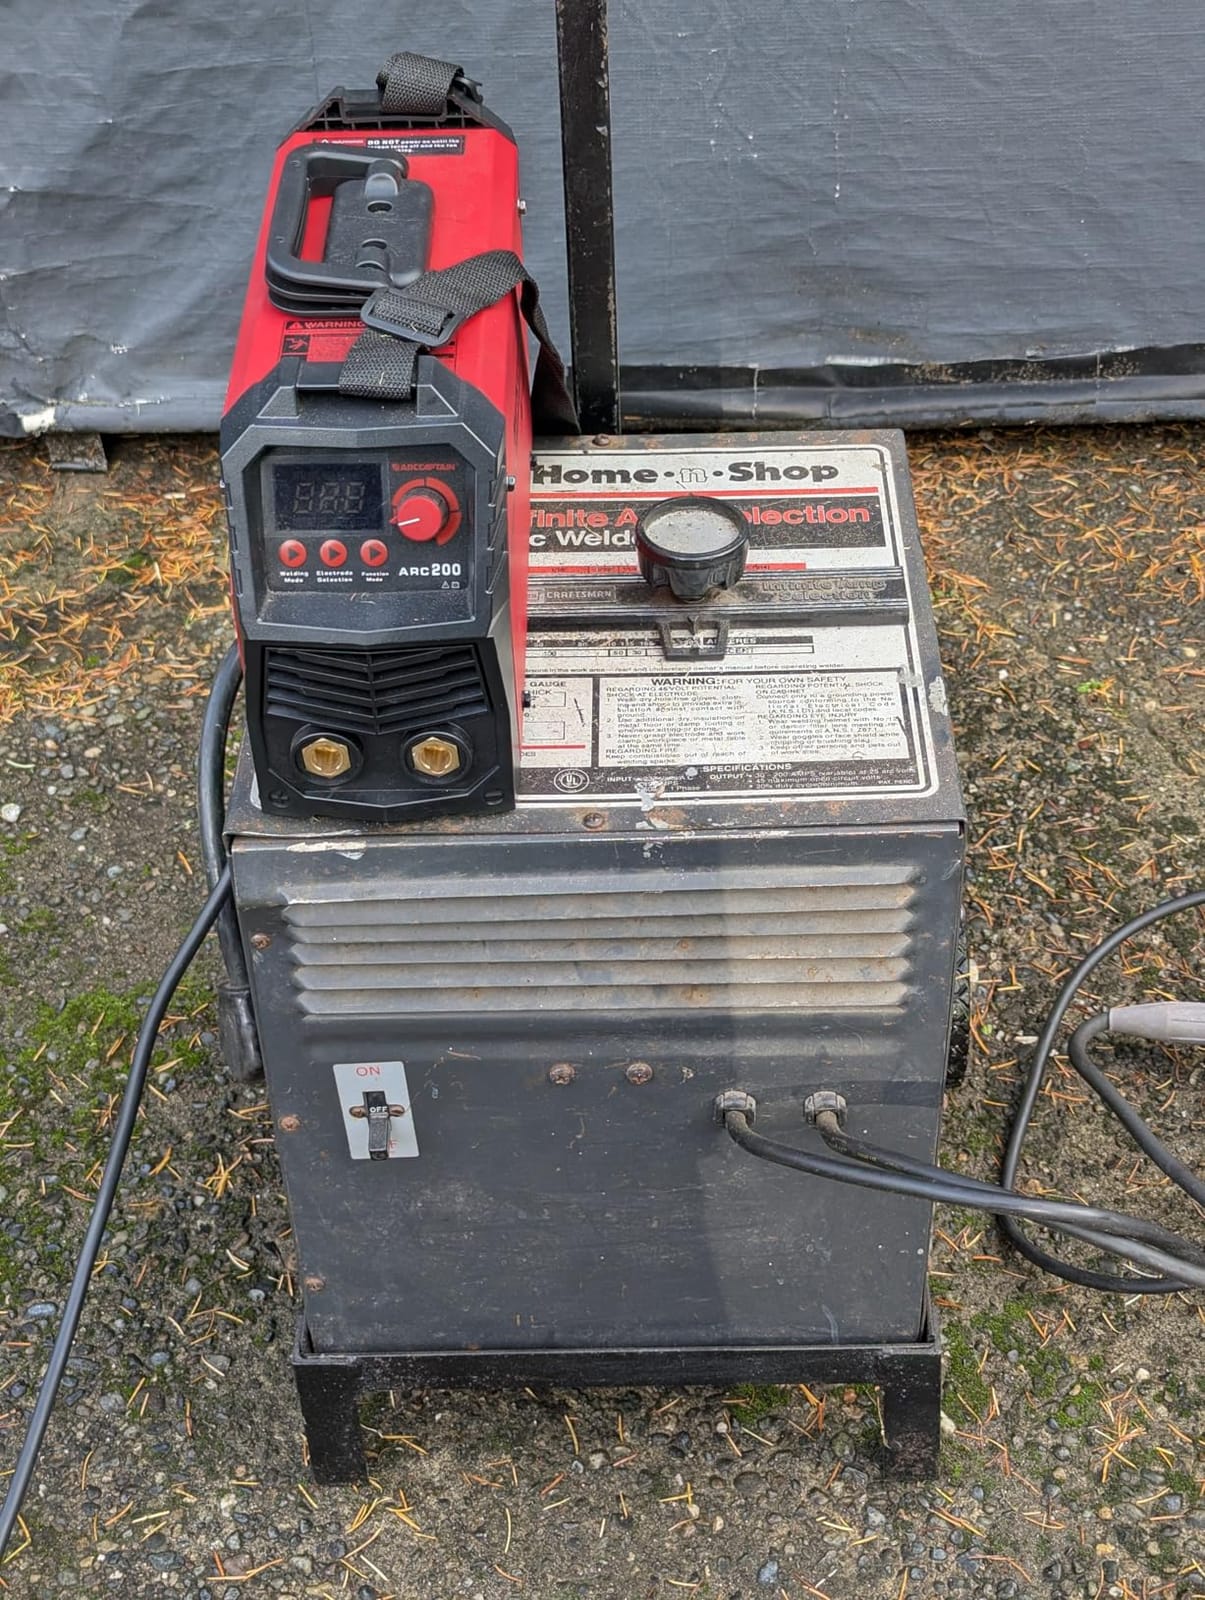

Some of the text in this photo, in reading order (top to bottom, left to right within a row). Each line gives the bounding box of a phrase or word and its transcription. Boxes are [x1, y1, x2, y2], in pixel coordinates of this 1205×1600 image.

[305, 321, 366, 329] WARNING
[533, 464, 657, 484] Home
[728, 461, 839, 483] Shop
[529, 509, 608, 527] finite
[556, 530, 637, 546] Weld
[546, 590, 612, 599] CRAFTSMAN
[651, 675, 847, 687] WARNING: FOR YOUR OWN SAFETY
[807, 681, 852, 690] POTENTIAL
[702, 763, 792, 773] SPECIFICATIONS
[357, 1067, 380, 1077] ON
[369, 1105, 388, 1113] OFF
